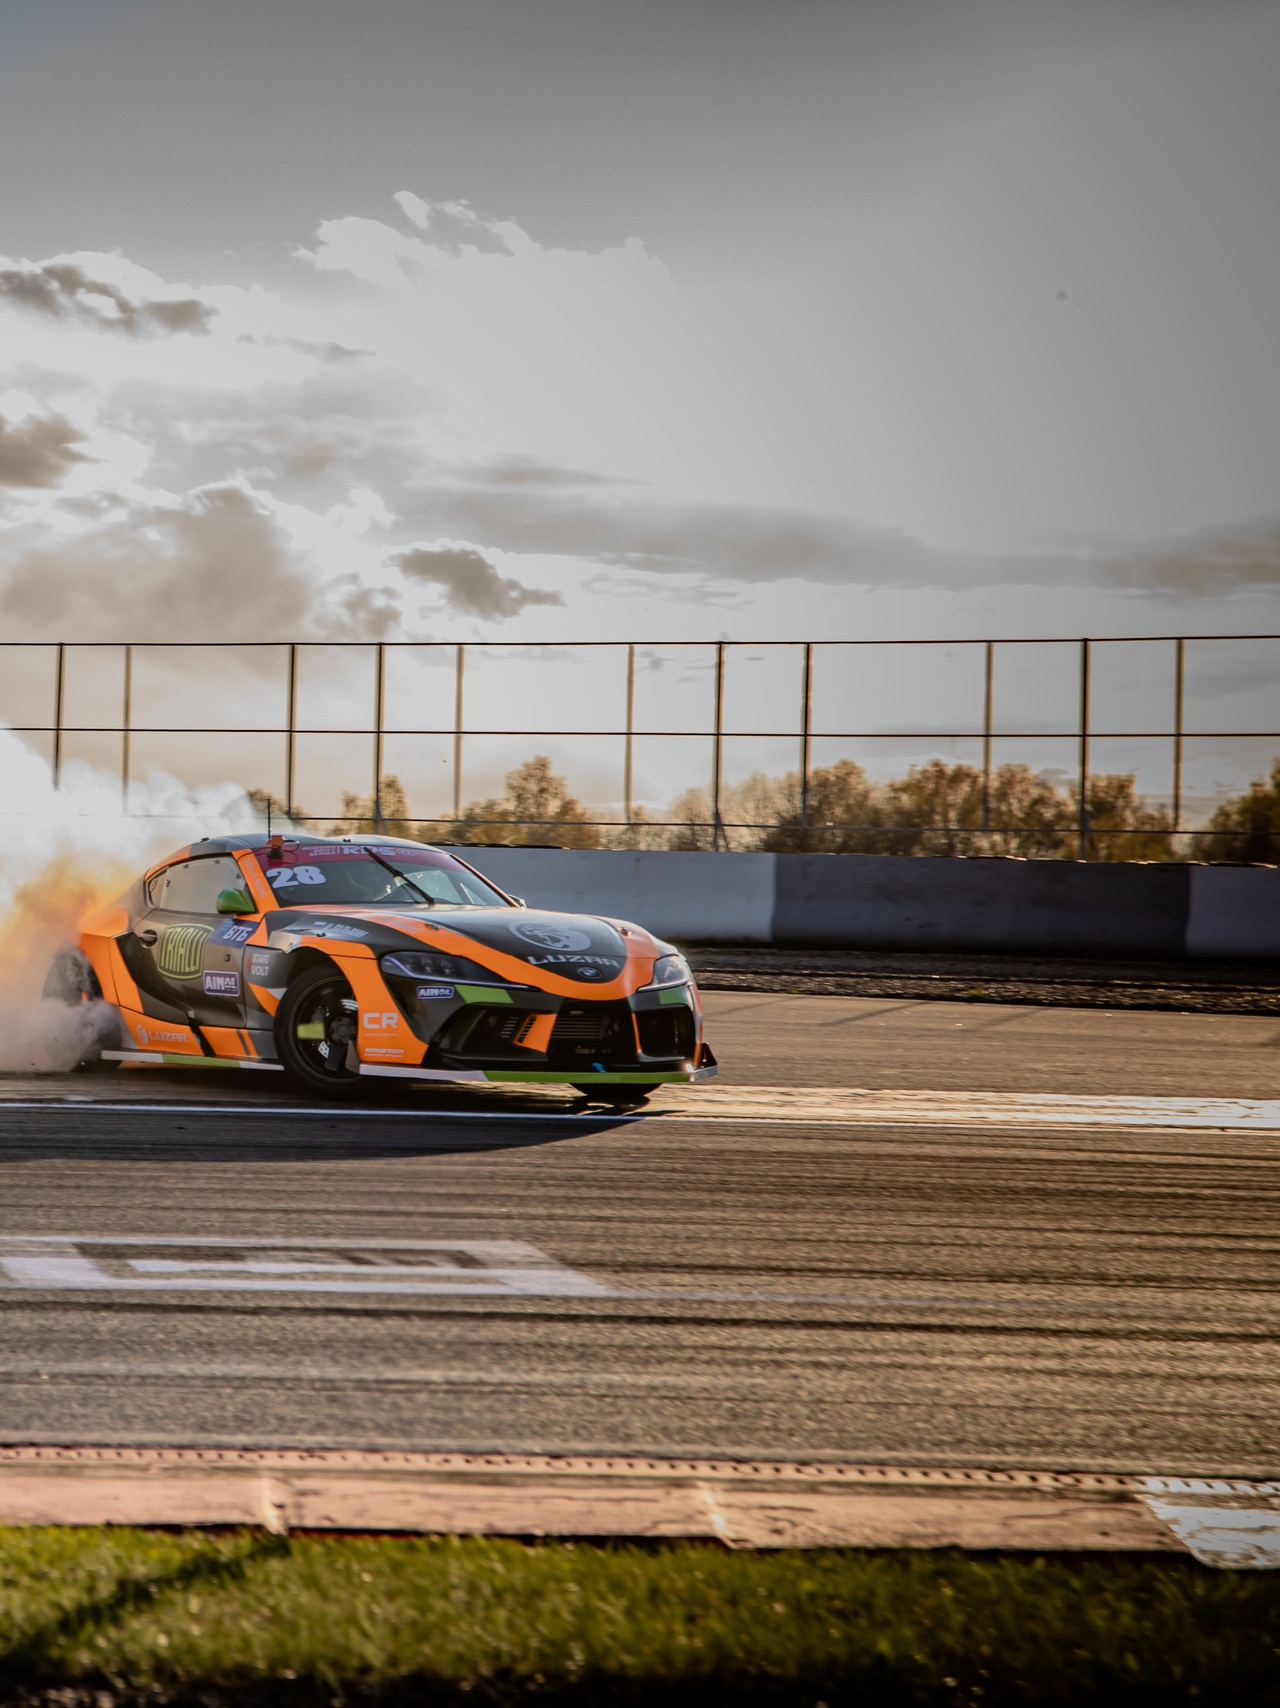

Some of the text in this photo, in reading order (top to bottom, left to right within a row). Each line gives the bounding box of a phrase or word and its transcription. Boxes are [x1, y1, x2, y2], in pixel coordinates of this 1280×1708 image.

[341, 845, 396, 856] RDS
[266, 866, 326, 889] 28
[223, 925, 253, 942] ВТБ
[252, 953, 270, 964] START
[527, 954, 621, 968] LUZAR
[251, 965, 270, 976] VOLT
[205, 975, 238, 991] AIMOL
[419, 988, 451, 997] AIMOL
[363, 1012, 398, 1029] CR
[148, 1030, 188, 1043] LUZAR
